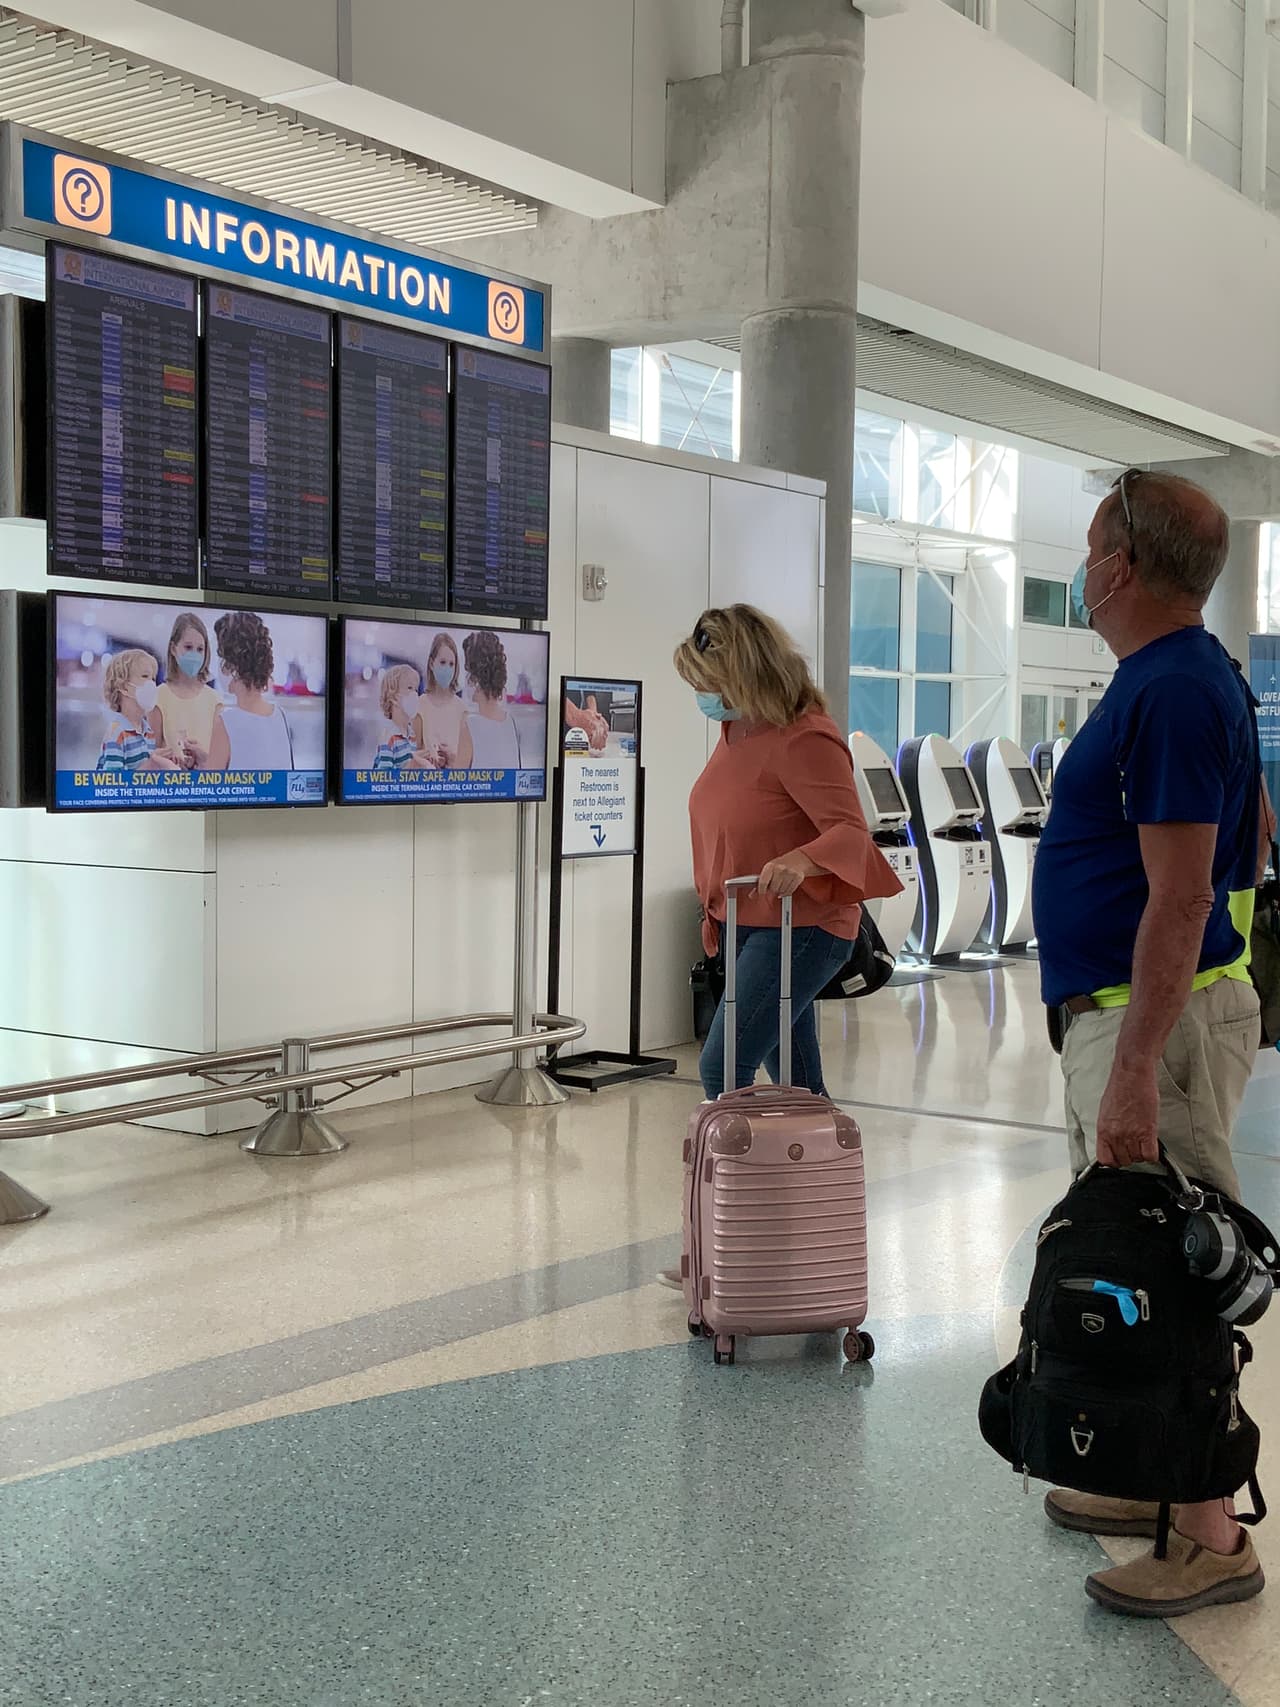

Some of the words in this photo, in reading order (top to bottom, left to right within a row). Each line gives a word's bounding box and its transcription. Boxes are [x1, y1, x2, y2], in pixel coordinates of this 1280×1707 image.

[166, 198, 450, 314] INFORMATION
[110, 295, 146, 311] ARRIVALS
[1260, 692, 1277, 702] LOVE
[581, 767, 593, 777] The
[595, 768, 619, 777] nearest
[74, 773, 89, 786] BE
[92, 773, 128, 787] WELL,
[132, 772, 160, 785] STAY
[164, 772, 194, 786] SAFE,
[198, 772, 222, 784] AND
[224, 772, 256, 784] MASK
[258, 772, 273, 784] UP
[356, 771, 368, 783] BE
[369, 771, 397, 784] WELL,
[399, 771, 420, 782] STAY
[422, 771, 446, 783] SAFE,
[448, 771, 466, 782] AND
[468, 771, 492, 781] MASK
[493, 771, 504, 781] UP
[95, 788, 119, 796] INSIDE
[119, 788, 133, 796] THE
[135, 788, 173, 796] TERMINALS
[174, 787, 190, 796] AND
[190, 787, 216, 795] RENTAL
[216, 787, 230, 795] CAR
[231, 787, 255, 795] CENTER
[390, 784, 400, 792] THE
[401, 784, 430, 792] TERMINALS
[580, 782, 612, 792] Restroom
[613, 783, 619, 791] is
[573, 798, 588, 806] next
[589, 797, 596, 806] to
[597, 796, 626, 808] Allegiant
[574, 811, 593, 821] ticket
[594, 811, 623, 821] counters
